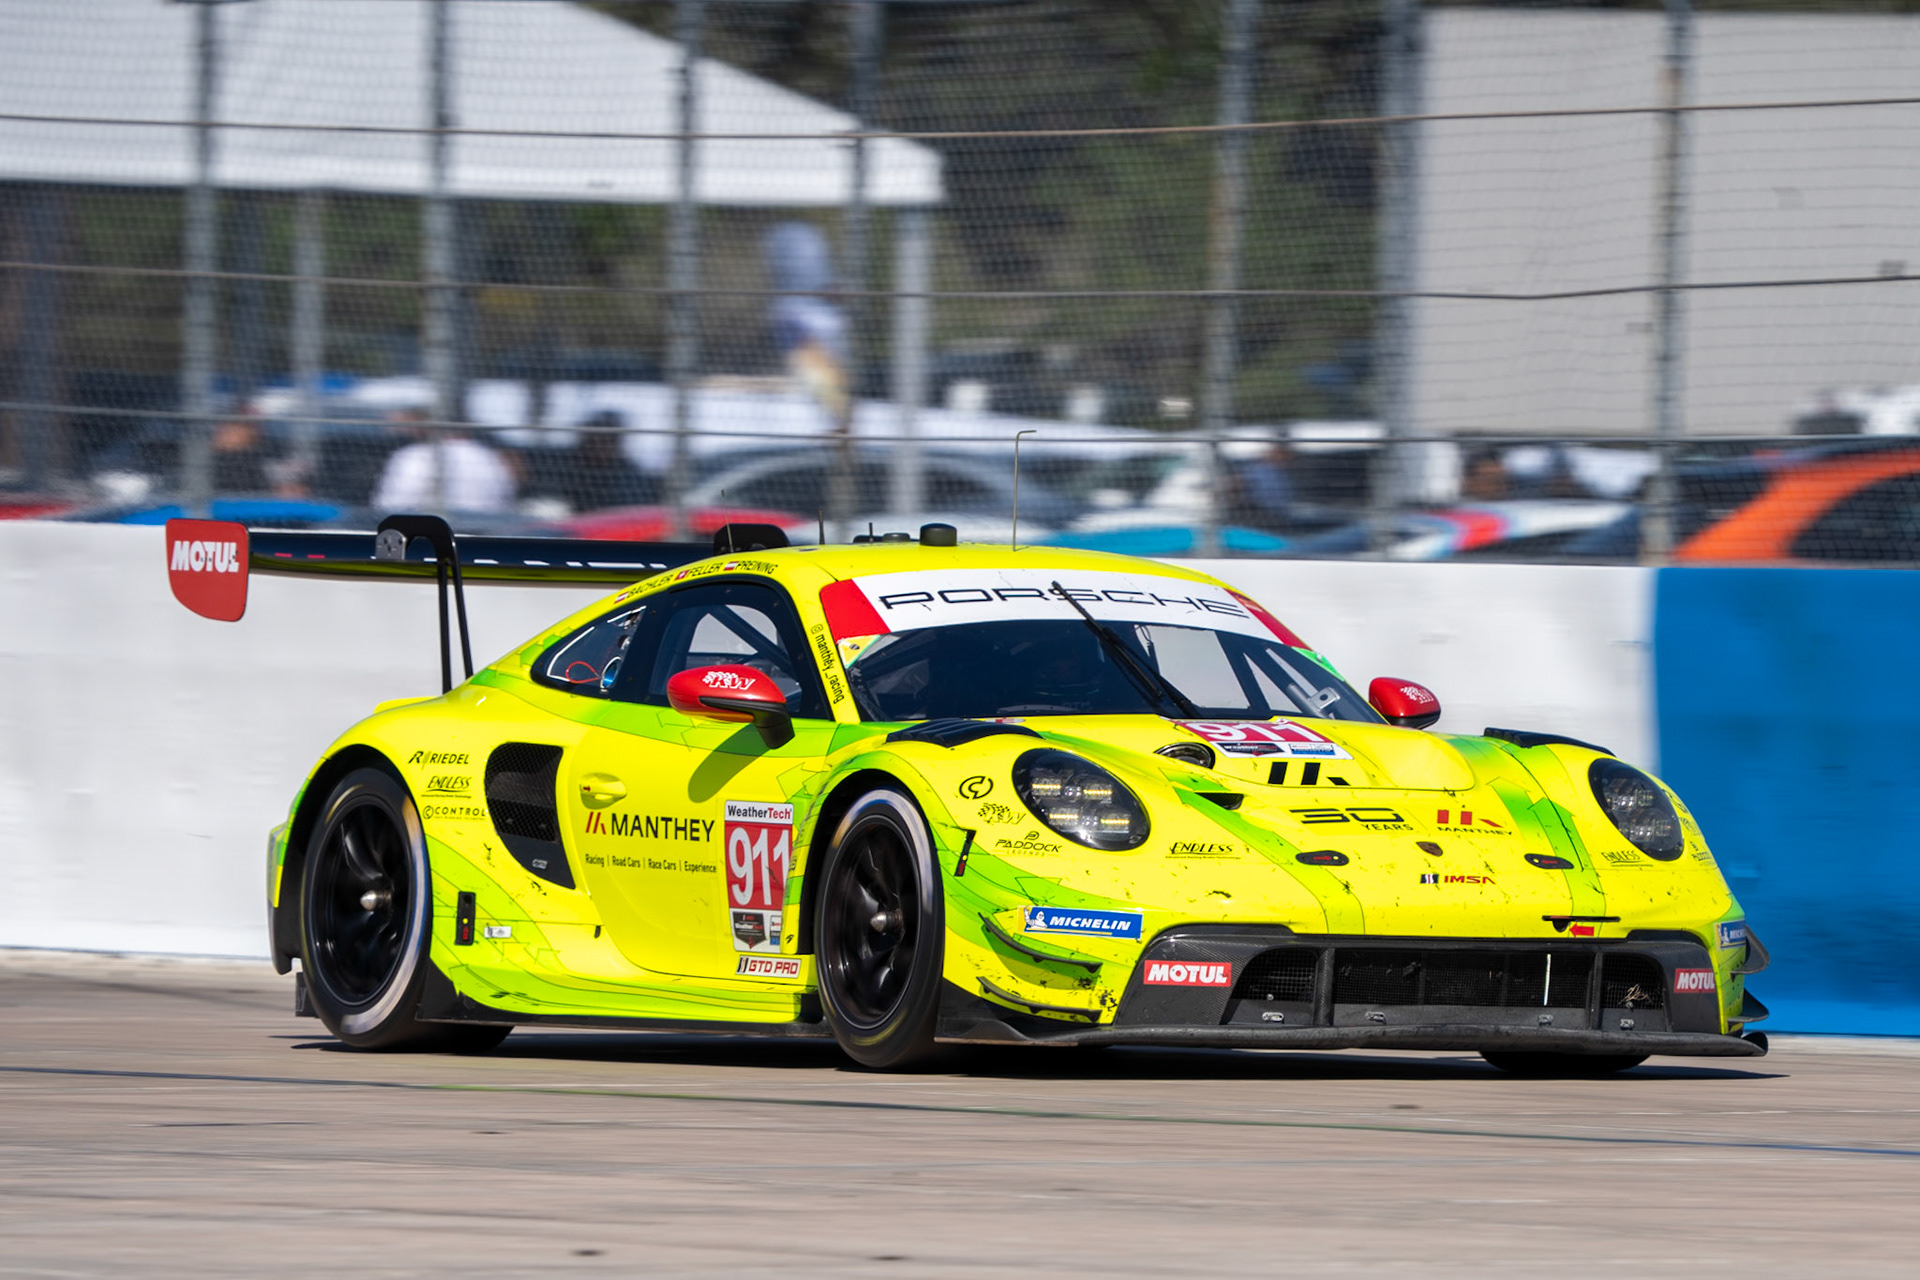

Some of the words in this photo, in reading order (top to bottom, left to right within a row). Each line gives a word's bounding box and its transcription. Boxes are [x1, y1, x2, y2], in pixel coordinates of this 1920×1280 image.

[170, 541, 240, 573] MOTUL
[688, 562, 724, 577] FELLER
[735, 560, 776, 575] PREINING
[879, 587, 1250, 619] PORSCHE
[815, 633, 845, 705] manthey_racing
[1185, 722, 1326, 742] 911
[429, 753, 470, 765] RIEDEL
[434, 806, 486, 817] CONTROL
[727, 805, 792, 820] WeatherTech
[1288, 807, 1405, 824] 30
[611, 812, 716, 842] MANTHEY
[1360, 823, 1414, 832] YEARS
[1436, 826, 1513, 836] MANTHEY
[995, 838, 1063, 853] PADDOCK
[1169, 841, 1234, 855] ENDLESS
[585, 853, 605, 868] Racing
[612, 856, 626, 867] Road
[628, 857, 641, 868] Cars
[648, 858, 662, 870] Race
[664, 859, 677, 871] Cars
[684, 861, 717, 873] Experience
[728, 826, 790, 906] 911
[1443, 875, 1496, 886] IMSA
[1049, 915, 1132, 931] MICHELIN
[748, 959, 773, 973] GTD
[773, 961, 799, 975] PRO
[1147, 964, 1228, 984] MOTUL
